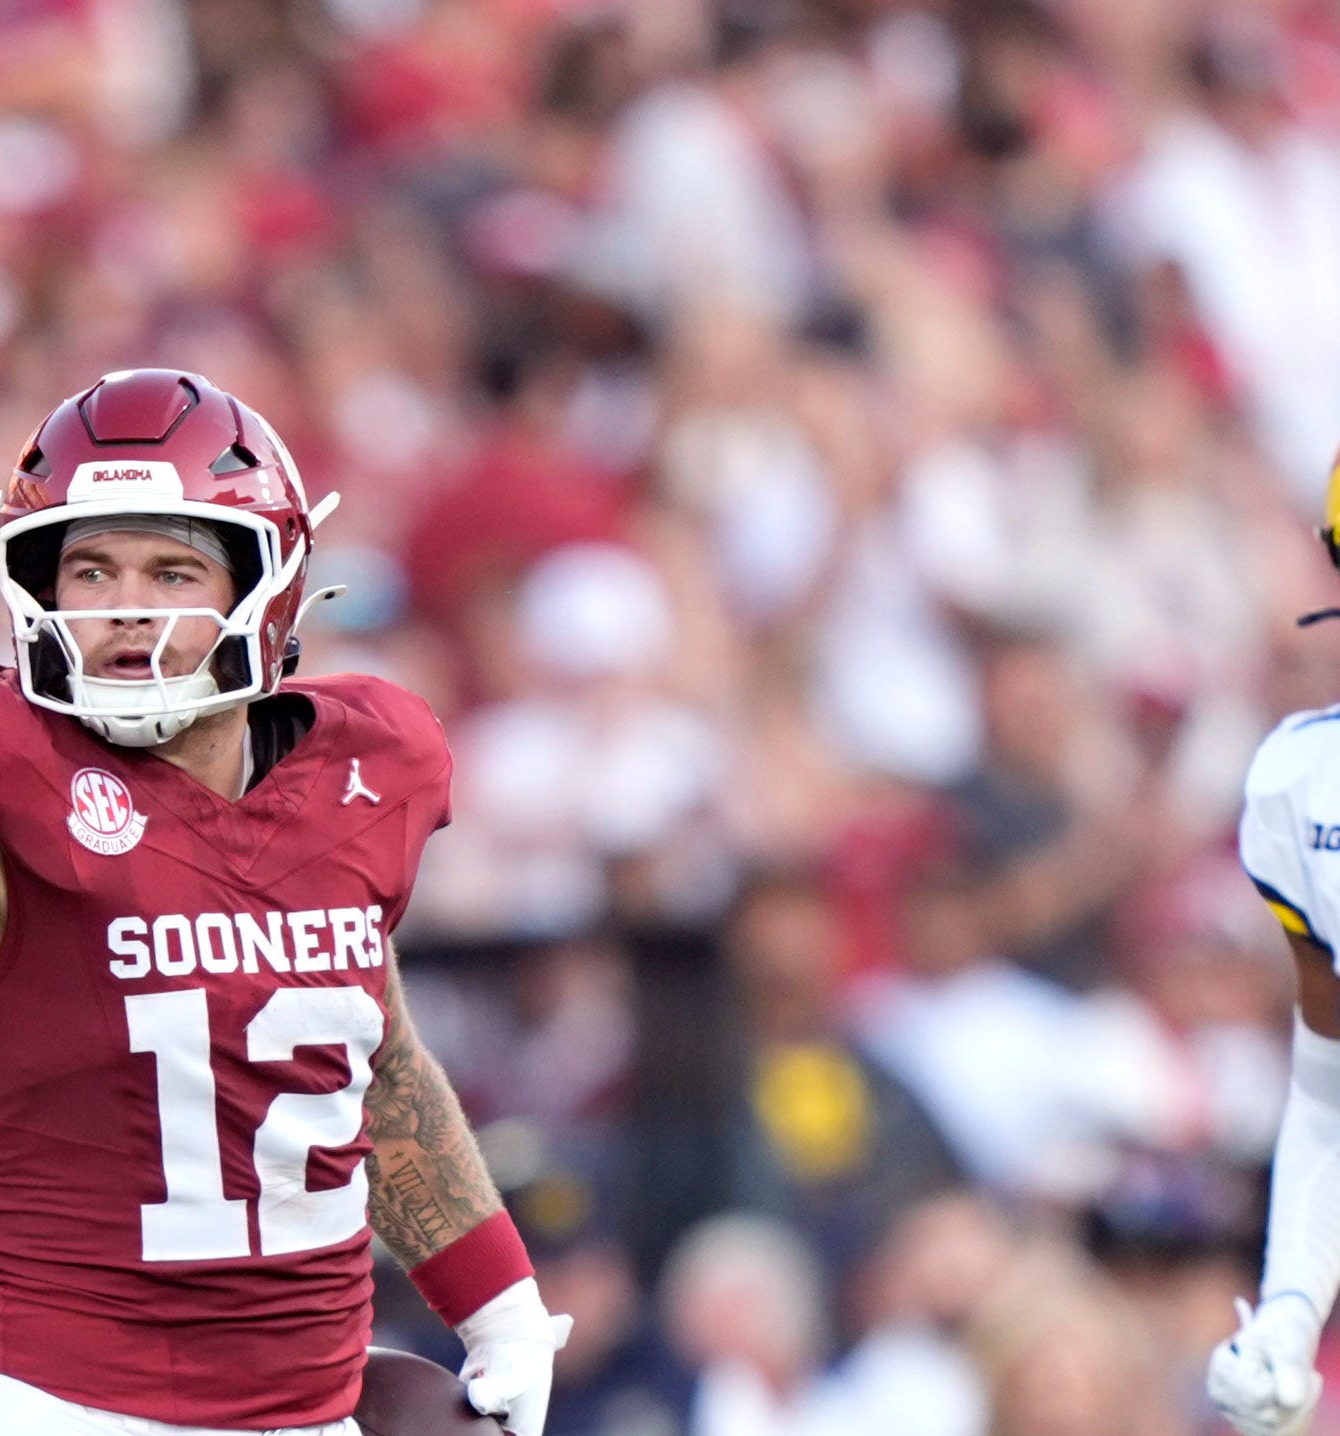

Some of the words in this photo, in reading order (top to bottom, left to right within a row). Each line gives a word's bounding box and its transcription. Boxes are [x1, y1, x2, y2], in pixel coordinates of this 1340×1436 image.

[92, 469, 153, 482] OKLAHOMA
[76, 772, 129, 832] SEC
[76, 827, 141, 853] GRADUATE
[108, 904, 383, 980] SOONERS
[124, 985, 386, 1262] 12
